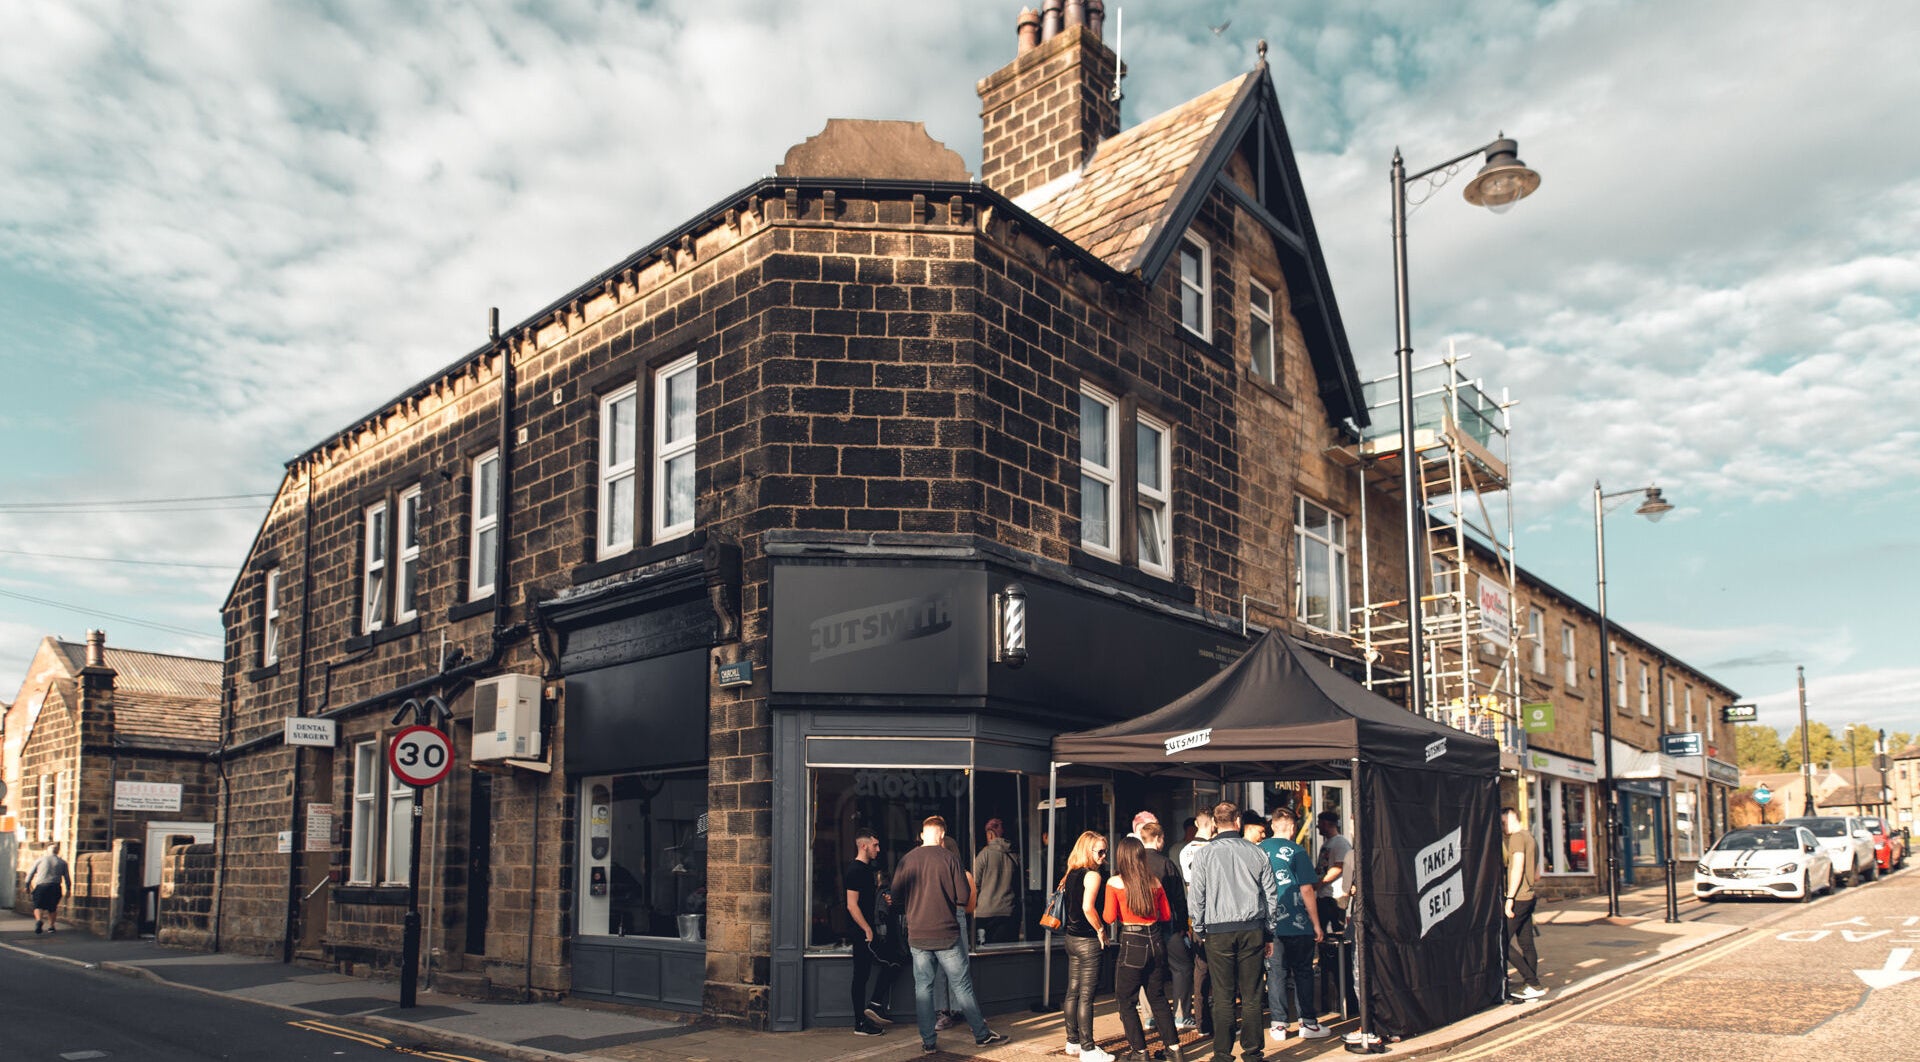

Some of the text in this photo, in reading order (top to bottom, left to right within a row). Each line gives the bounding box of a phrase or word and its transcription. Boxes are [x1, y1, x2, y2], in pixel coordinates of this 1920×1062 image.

[296, 723, 327, 732] DENTAL
[293, 732, 330, 741] SURGERY
[1165, 732, 1211, 752] CUTSMITH
[399, 741, 445, 768] 30
[118, 783, 179, 793] SHIELD
[1275, 780, 1301, 791] PAINTS
[1422, 842, 1454, 877] TAKE A
[1429, 886, 1452, 918] SEAT
